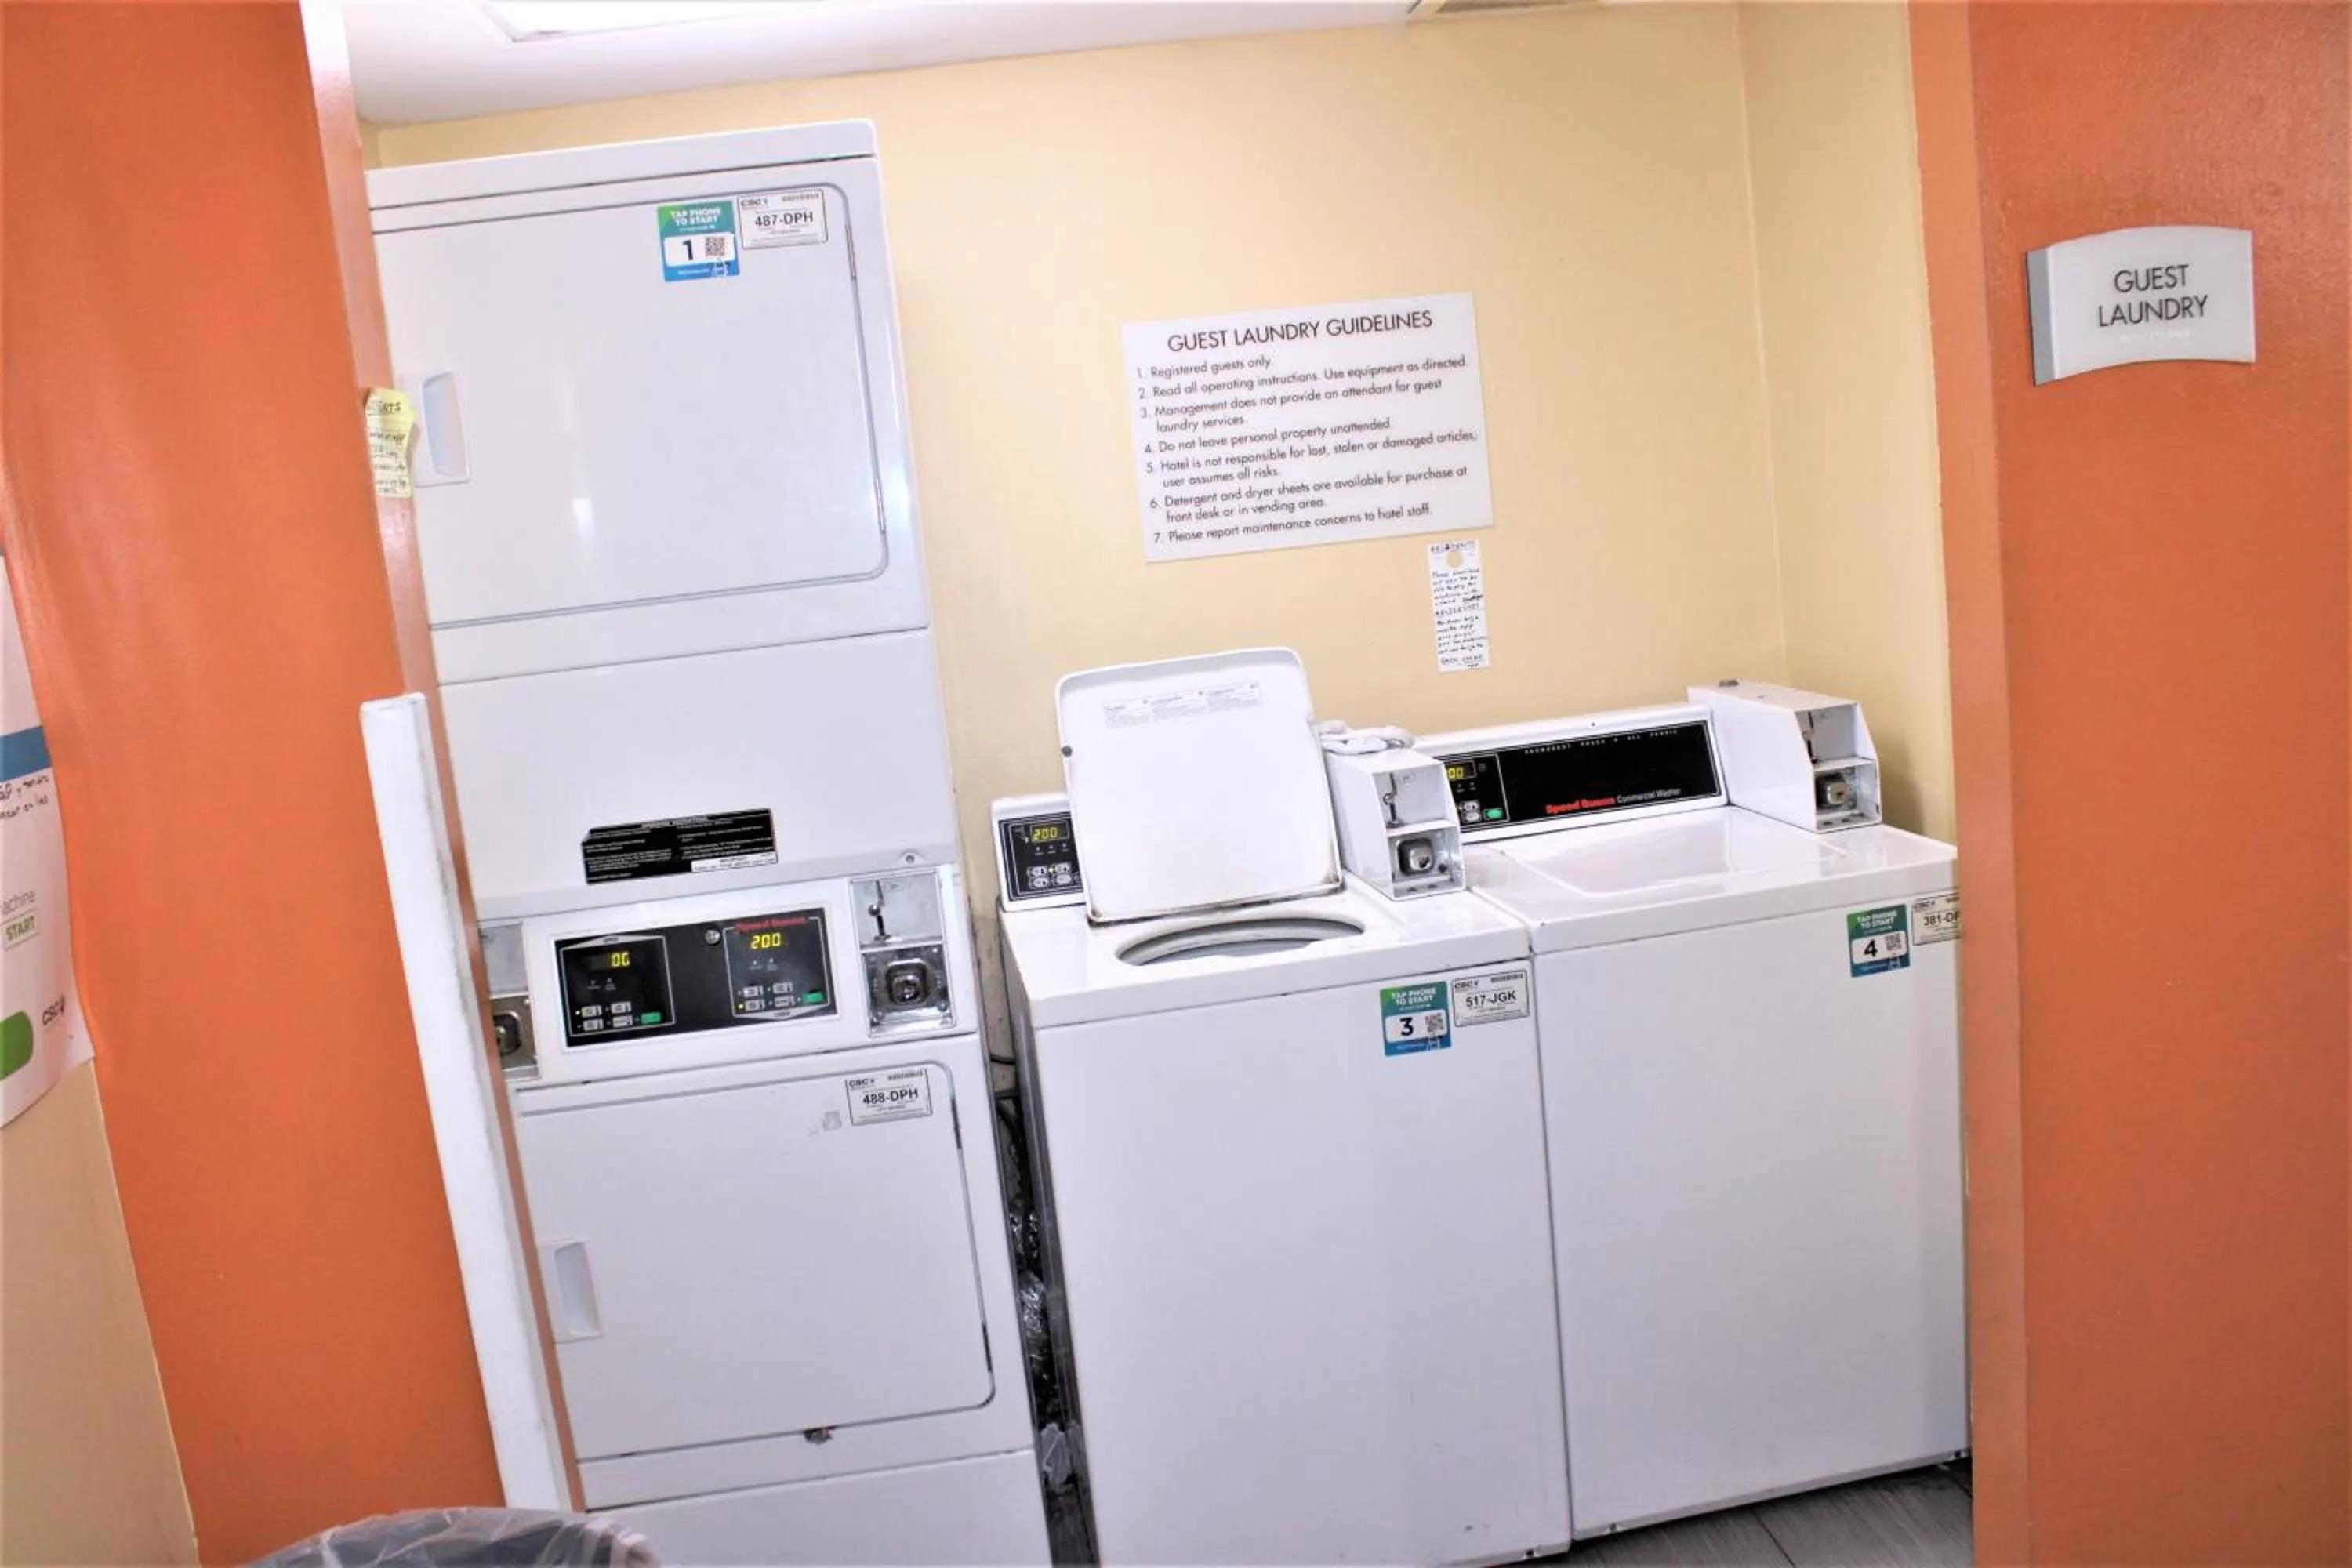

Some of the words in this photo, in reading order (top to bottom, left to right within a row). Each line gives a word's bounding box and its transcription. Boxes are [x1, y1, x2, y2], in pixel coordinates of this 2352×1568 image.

[755, 211, 814, 227] 487-DPH
[682, 238, 694, 261] 1
[2114, 263, 2190, 293] GUEST
[2098, 294, 2209, 327] LAUNDRY
[1167, 329, 1229, 352] GUEST
[1234, 321, 1319, 346] LAUNDRY
[1326, 310, 1433, 336] GUIDELINES
[1150, 361, 1208, 380] Registered
[1210, 359, 1245, 376] guests
[1152, 382, 1181, 397] Read
[1184, 379, 1199, 394] all
[1200, 378, 1255, 394] operating
[1324, 368, 1345, 381] Use
[1347, 363, 1404, 380] equipment
[1406, 363, 1420, 372] as
[1154, 401, 1227, 417] Management
[1230, 396, 1258, 409] does
[1259, 394, 1278, 406] not
[1279, 388, 1322, 407] provide
[1323, 390, 1339, 400] an
[1341, 382, 1392, 398] attendant
[1394, 379, 1411, 393] for
[1413, 379, 1442, 394] guest
[1156, 417, 1199, 434] laundry
[1158, 440, 1176, 452] Do
[1178, 439, 1196, 451] not
[1197, 435, 1229, 448] leave
[1230, 427, 1278, 448] personal
[1280, 426, 1327, 443] property
[1160, 457, 1189, 472] Hotel
[1192, 459, 1202, 469] is
[1204, 456, 1223, 467] not
[1225, 448, 1287, 466] responsible
[1289, 445, 1305, 459] for
[1334, 440, 1365, 454] stolen
[1367, 441, 1379, 451] or
[1381, 432, 1434, 449] damaged
[1163, 477, 1185, 488] user
[1188, 473, 1235, 485] assumes
[1236, 466, 1250, 481] all
[1163, 492, 1218, 508] Detergent
[1219, 486, 1243, 502] and
[1243, 485, 1274, 501] dryer
[1277, 482, 1311, 496] sheets
[1312, 481, 1332, 492] are
[1334, 473, 1385, 490] available
[1386, 470, 1403, 484] for
[1404, 466, 1454, 485] purchase
[1456, 466, 1468, 477] at
[1166, 510, 1192, 523] front
[1194, 506, 1220, 521] desk
[1222, 508, 1235, 517] or
[1238, 504, 1249, 515] in
[1251, 499, 1296, 514] vending
[1167, 529, 1203, 543] Please
[1206, 526, 1240, 540] report
[1242, 519, 1312, 534] maintenance
[1313, 514, 1362, 528] concerns
[1363, 511, 1376, 521] to
[1377, 506, 1404, 520] hotel
[1032, 826, 1058, 842] 200
[1, 890, 36, 916] achine
[5, 915, 35, 941] START
[750, 932, 782, 949] 200
[1864, 938, 1878, 958] 4
[1465, 990, 1517, 1007] 517-JGK
[1399, 1017, 1414, 1036] 3
[863, 1087, 919, 1105] 488-DPH
